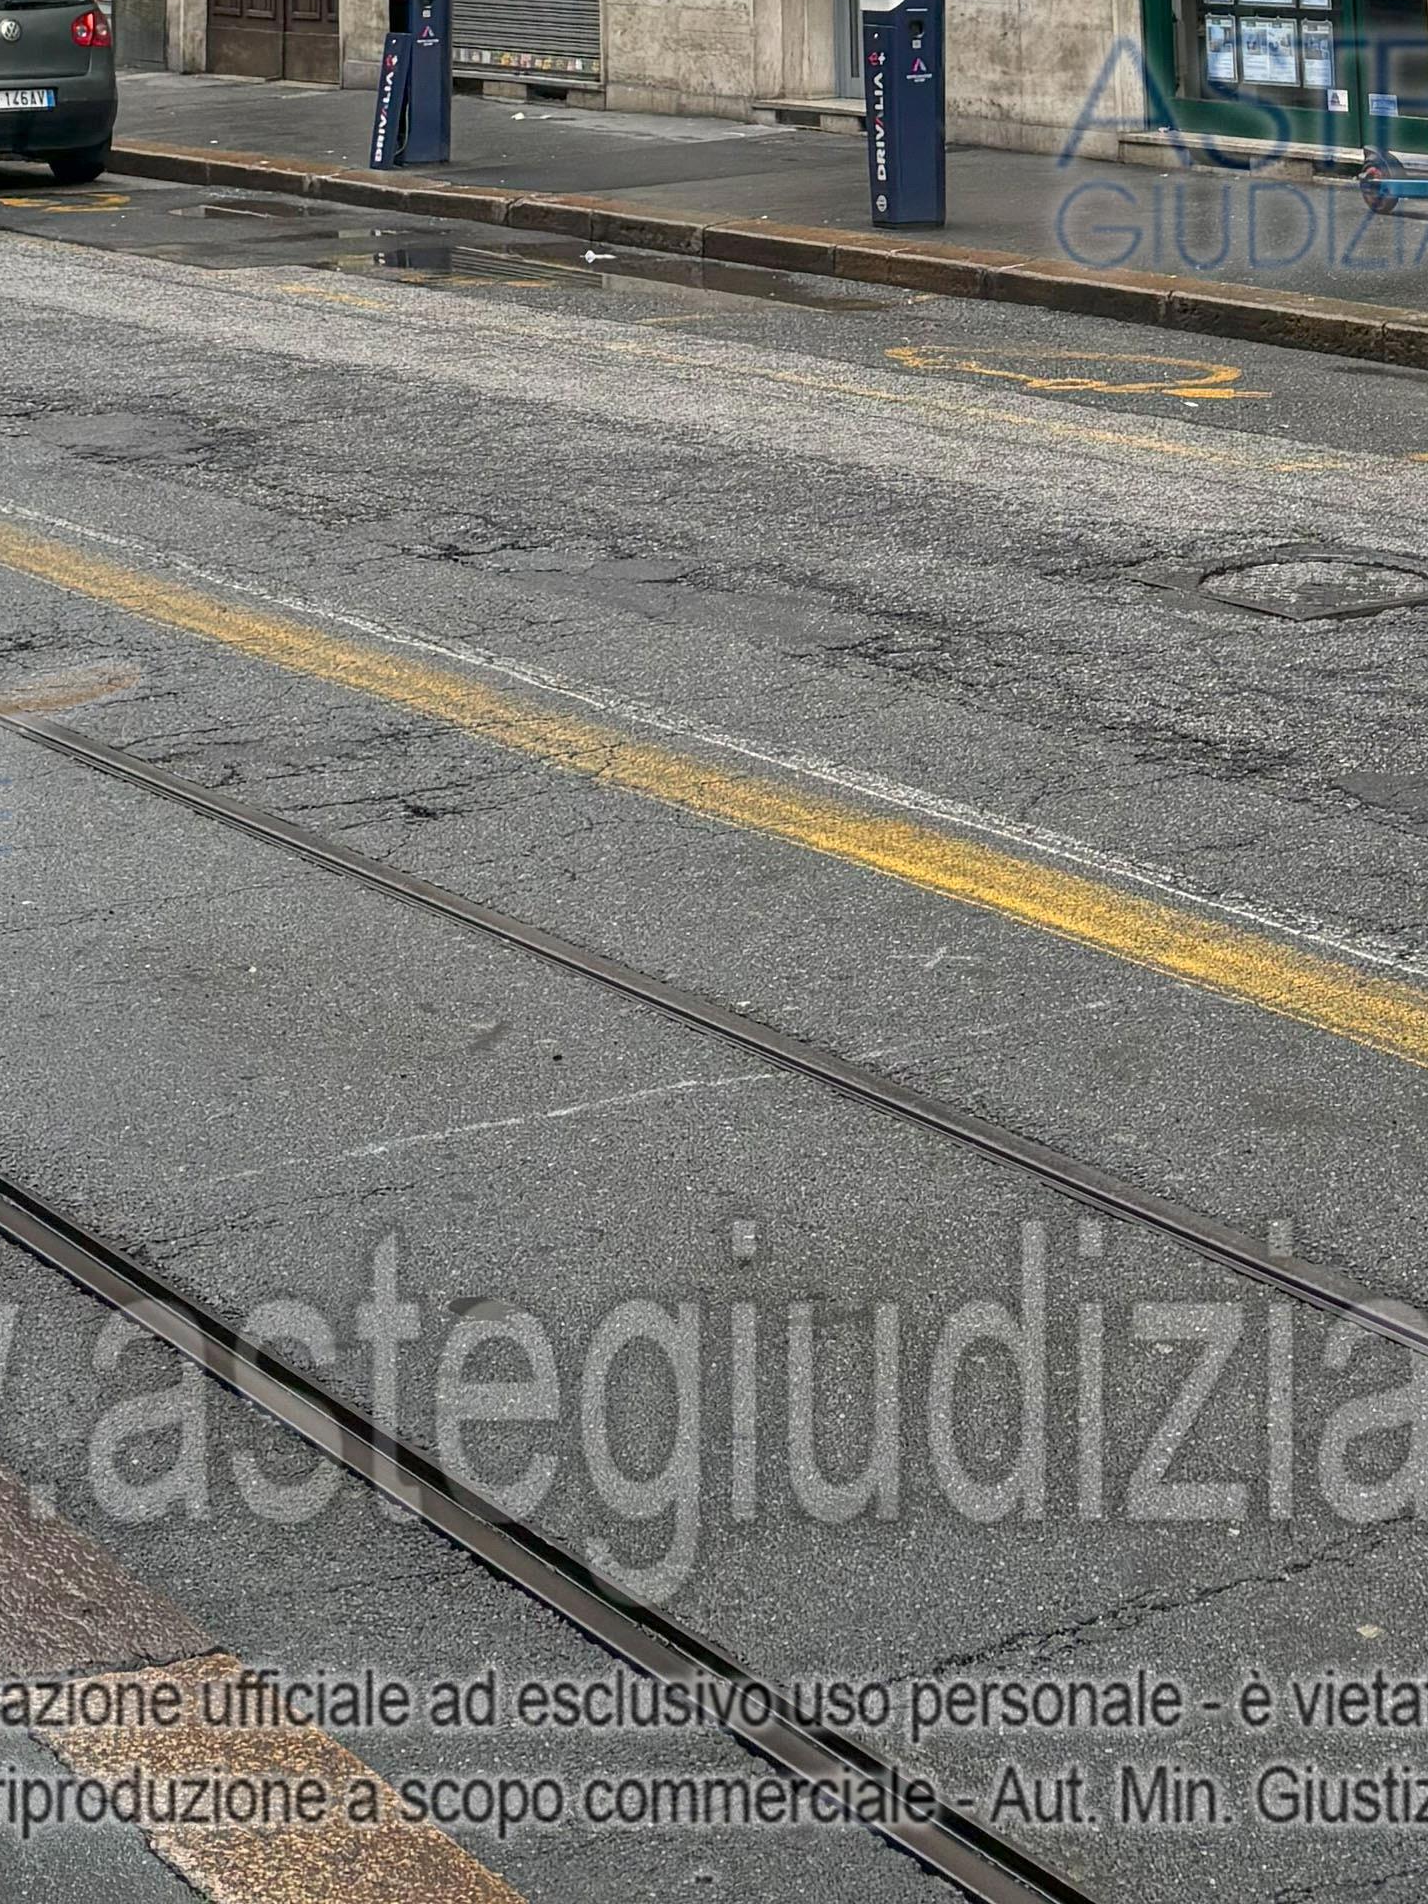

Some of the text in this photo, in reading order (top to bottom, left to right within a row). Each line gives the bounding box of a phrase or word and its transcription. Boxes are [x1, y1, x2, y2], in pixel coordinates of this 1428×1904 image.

[5, 90, 45, 107] 146AV
[374, 71, 394, 163] DRIVALIA
[873, 72, 887, 181] DRIVALIA
